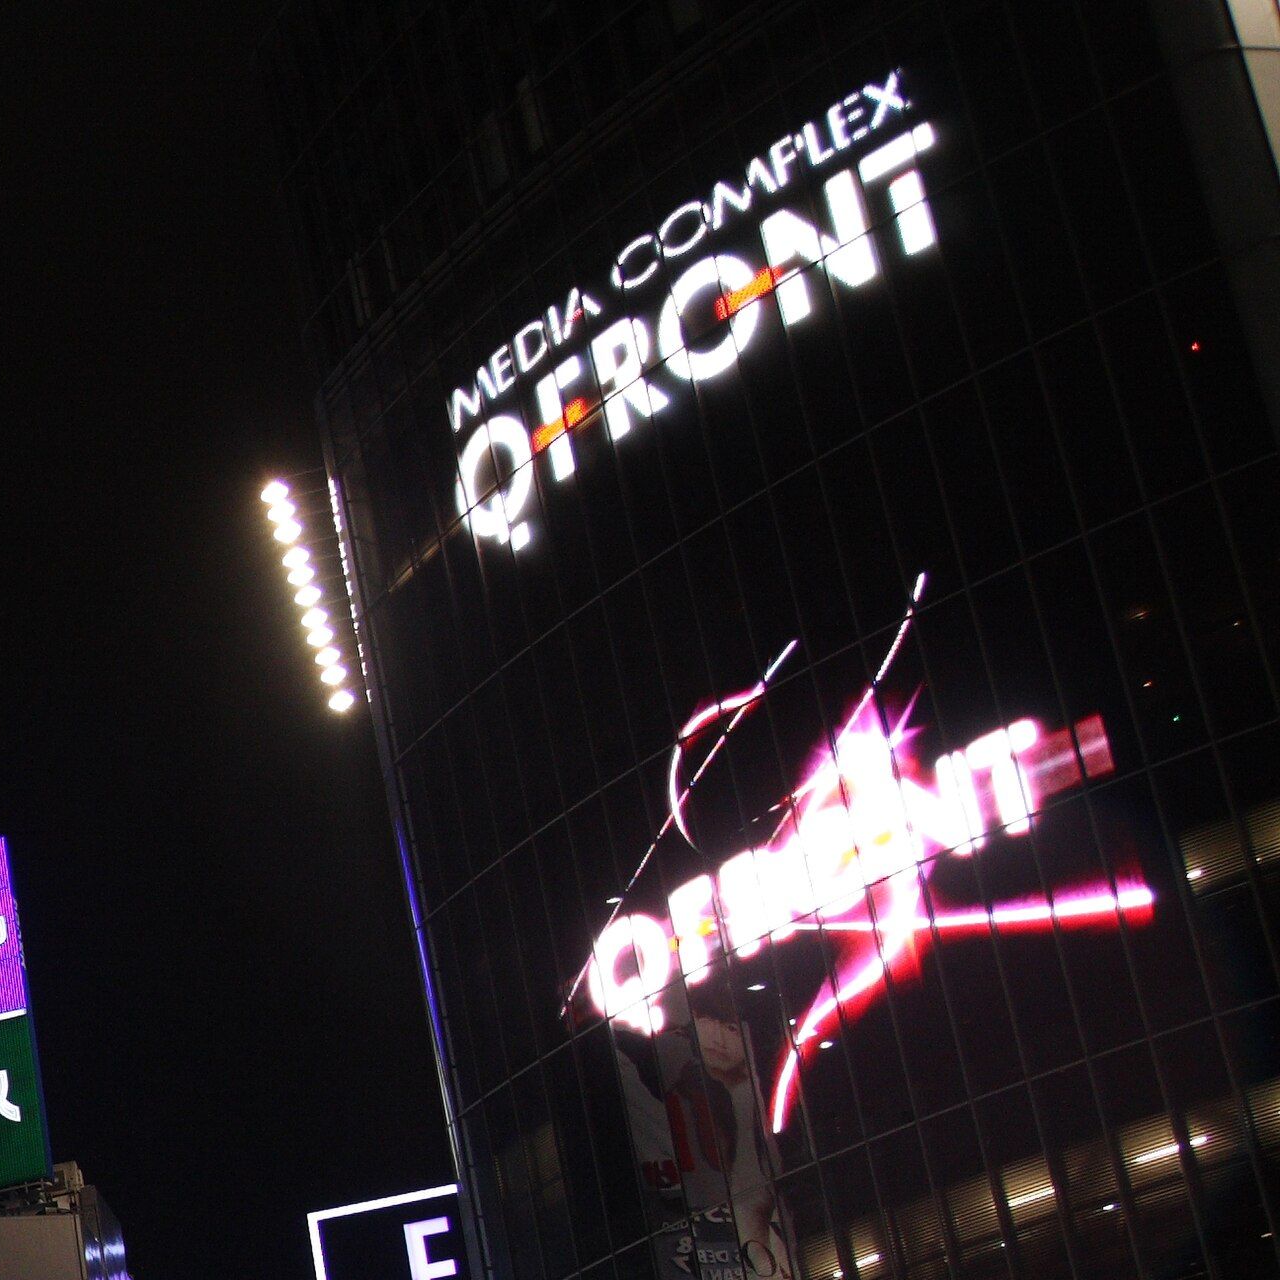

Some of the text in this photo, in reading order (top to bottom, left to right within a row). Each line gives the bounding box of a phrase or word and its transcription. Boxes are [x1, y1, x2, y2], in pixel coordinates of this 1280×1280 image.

[446, 67, 912, 433] MEDIA COMPLEX
[456, 120, 937, 551] QFRONT
